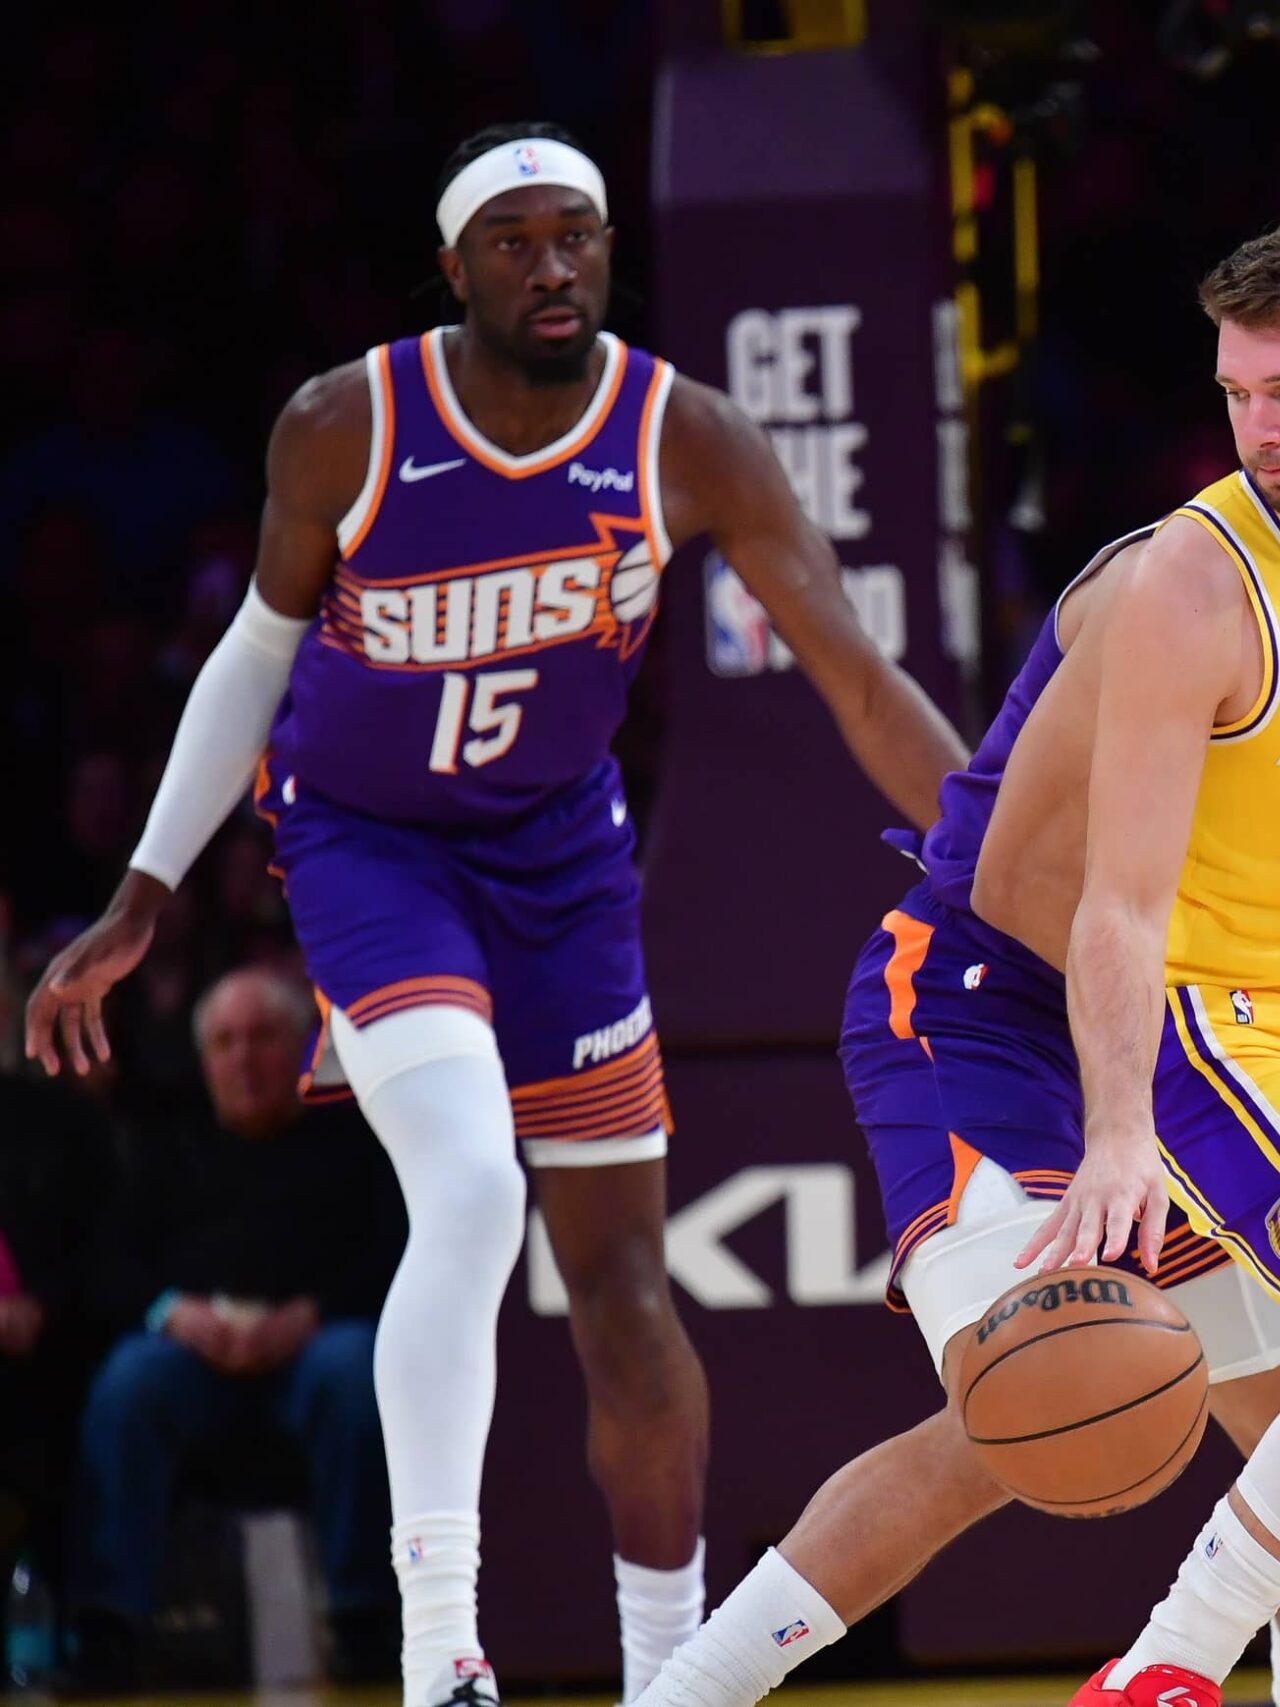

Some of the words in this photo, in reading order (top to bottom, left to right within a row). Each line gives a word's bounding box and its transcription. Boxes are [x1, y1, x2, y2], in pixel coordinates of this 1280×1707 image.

[726, 303, 862, 424] GET
[567, 461, 635, 494] PayPal
[359, 556, 602, 665] SUNS
[428, 667, 540, 775] 15
[975, 1277, 1132, 1345] Wilson
